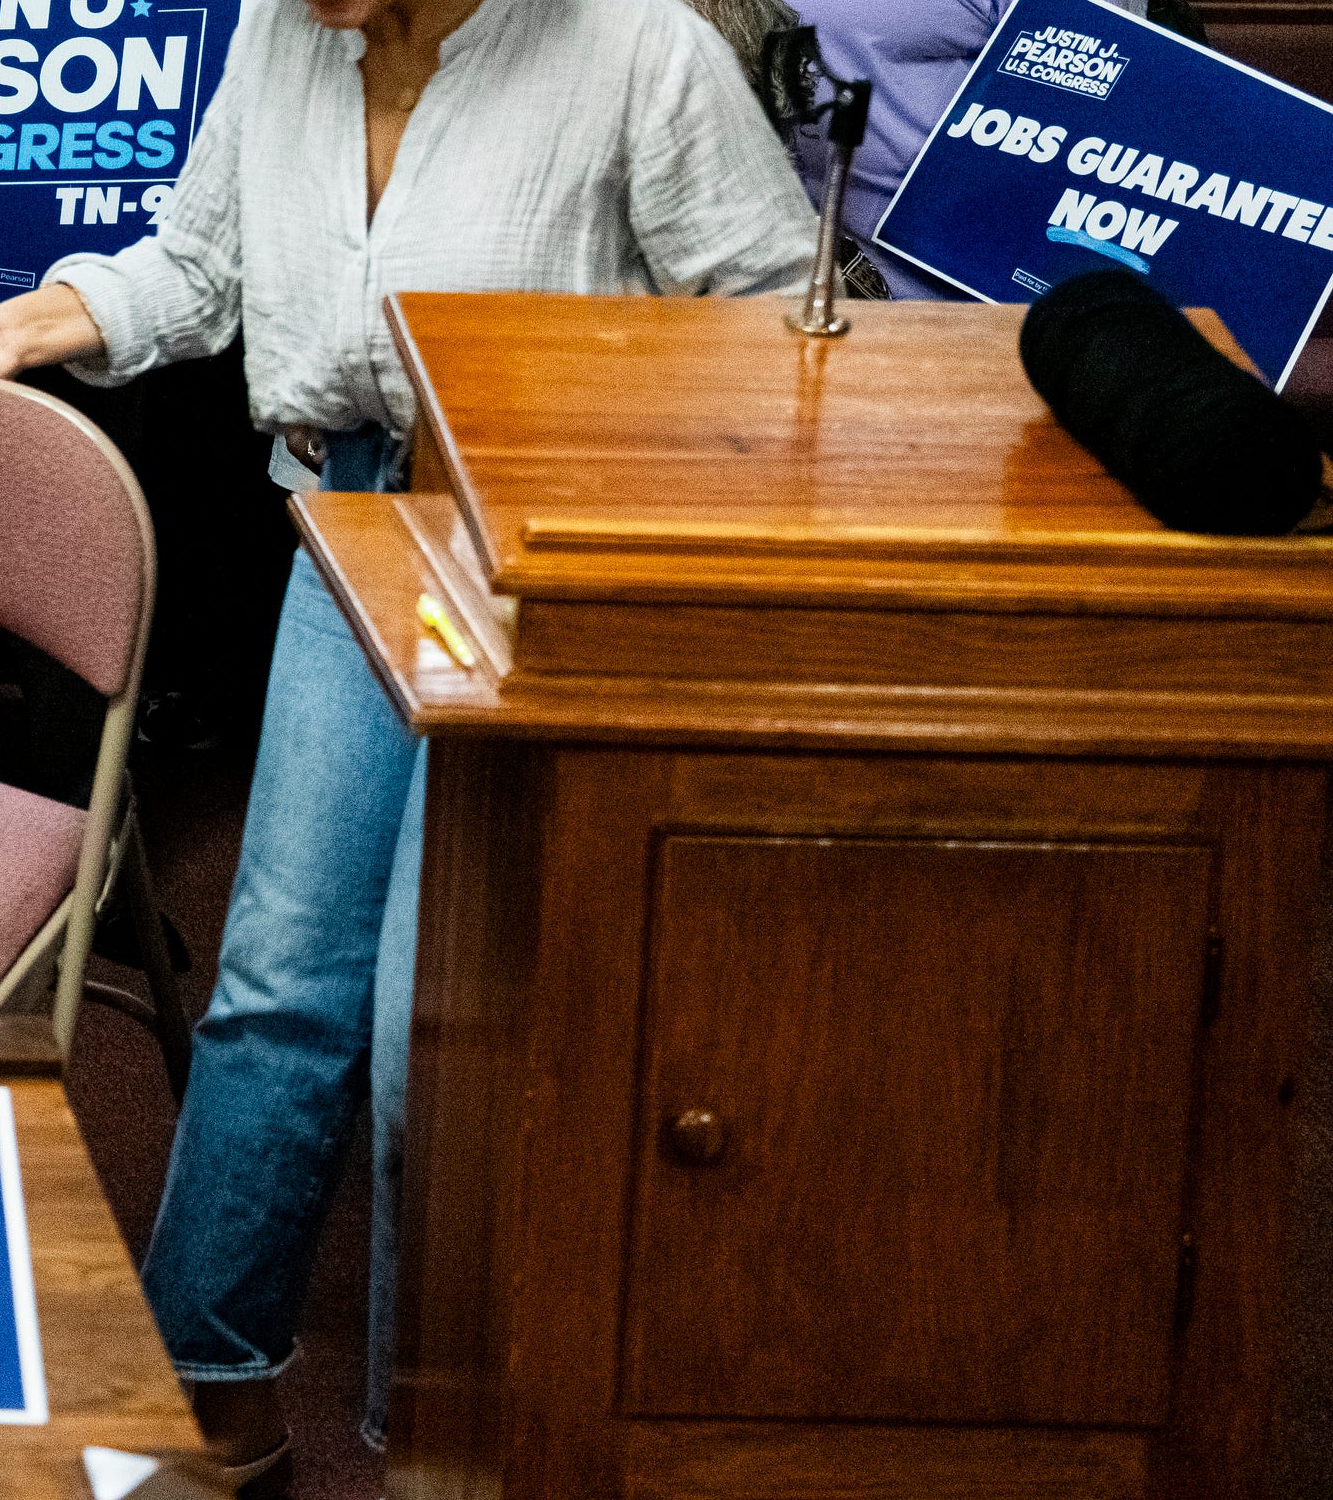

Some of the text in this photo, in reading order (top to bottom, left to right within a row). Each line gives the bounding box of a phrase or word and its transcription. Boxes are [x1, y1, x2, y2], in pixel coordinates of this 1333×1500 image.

[1013, 38, 1122, 83] PEARSON
[1035, 26, 1098, 55] JUSTIN
[947, 103, 1068, 163] JOBS
[55, 184, 175, 225] TN-9
[1048, 188, 1179, 256] NOW
[1, 273, 32, 283] Pearson
